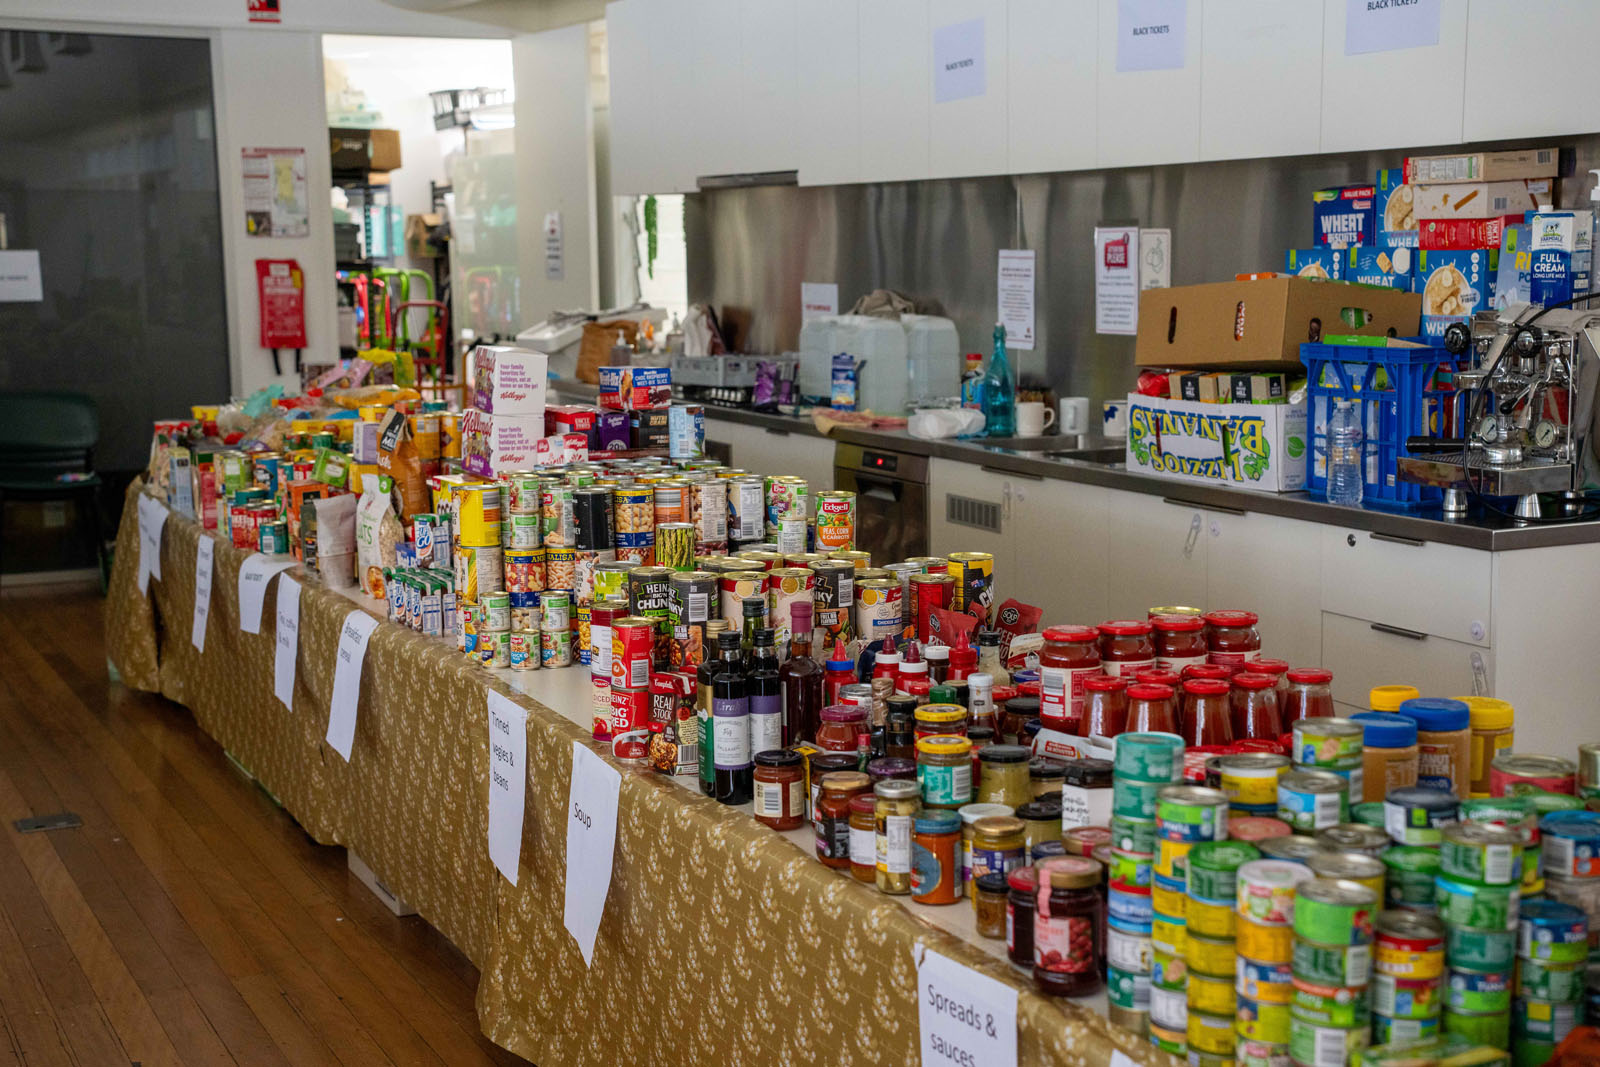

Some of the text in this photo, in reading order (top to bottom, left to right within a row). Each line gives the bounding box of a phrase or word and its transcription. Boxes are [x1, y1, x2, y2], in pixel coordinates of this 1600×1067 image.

[1367, 0, 1389, 11] BLACK
[1132, 25, 1170, 36] BLACK TICKETS
[1321, 213, 1365, 233] WHEAT
[1387, 238, 1419, 248] WHEA
[1515, 252, 1532, 270] RI
[1540, 253, 1561, 263] FULL
[1534, 263, 1566, 273] CREAM
[1357, 276, 1395, 287] WHEAT
[1518, 272, 1531, 283] PO
[500, 391, 526, 400] Kellogg's
[1131, 406, 1266, 457] BANANAS
[499, 454, 525, 463] Kellogg's
[824, 503, 849, 512] Edgell
[358, 524, 372, 545] ATS
[823, 527, 836, 535] PEAS,
[547, 553, 574, 561] NALISA
[646, 583, 668, 594] HEIN
[637, 598, 668, 610] CHUN
[668, 602, 684, 616] NKY
[1002, 610, 1018, 620] SOUP
[611, 695, 629, 705] EINZ
[653, 694, 672, 711] REAL
[652, 708, 672, 721] STOCK
[491, 711, 510, 736] Tinned
[722, 727, 733, 736] Fig
[509, 752, 514, 768] &
[493, 767, 509, 791] beans
[573, 802, 592, 830] Soup
[927, 983, 998, 1040] Spreads &
[930, 1032, 976, 1067] sauces
